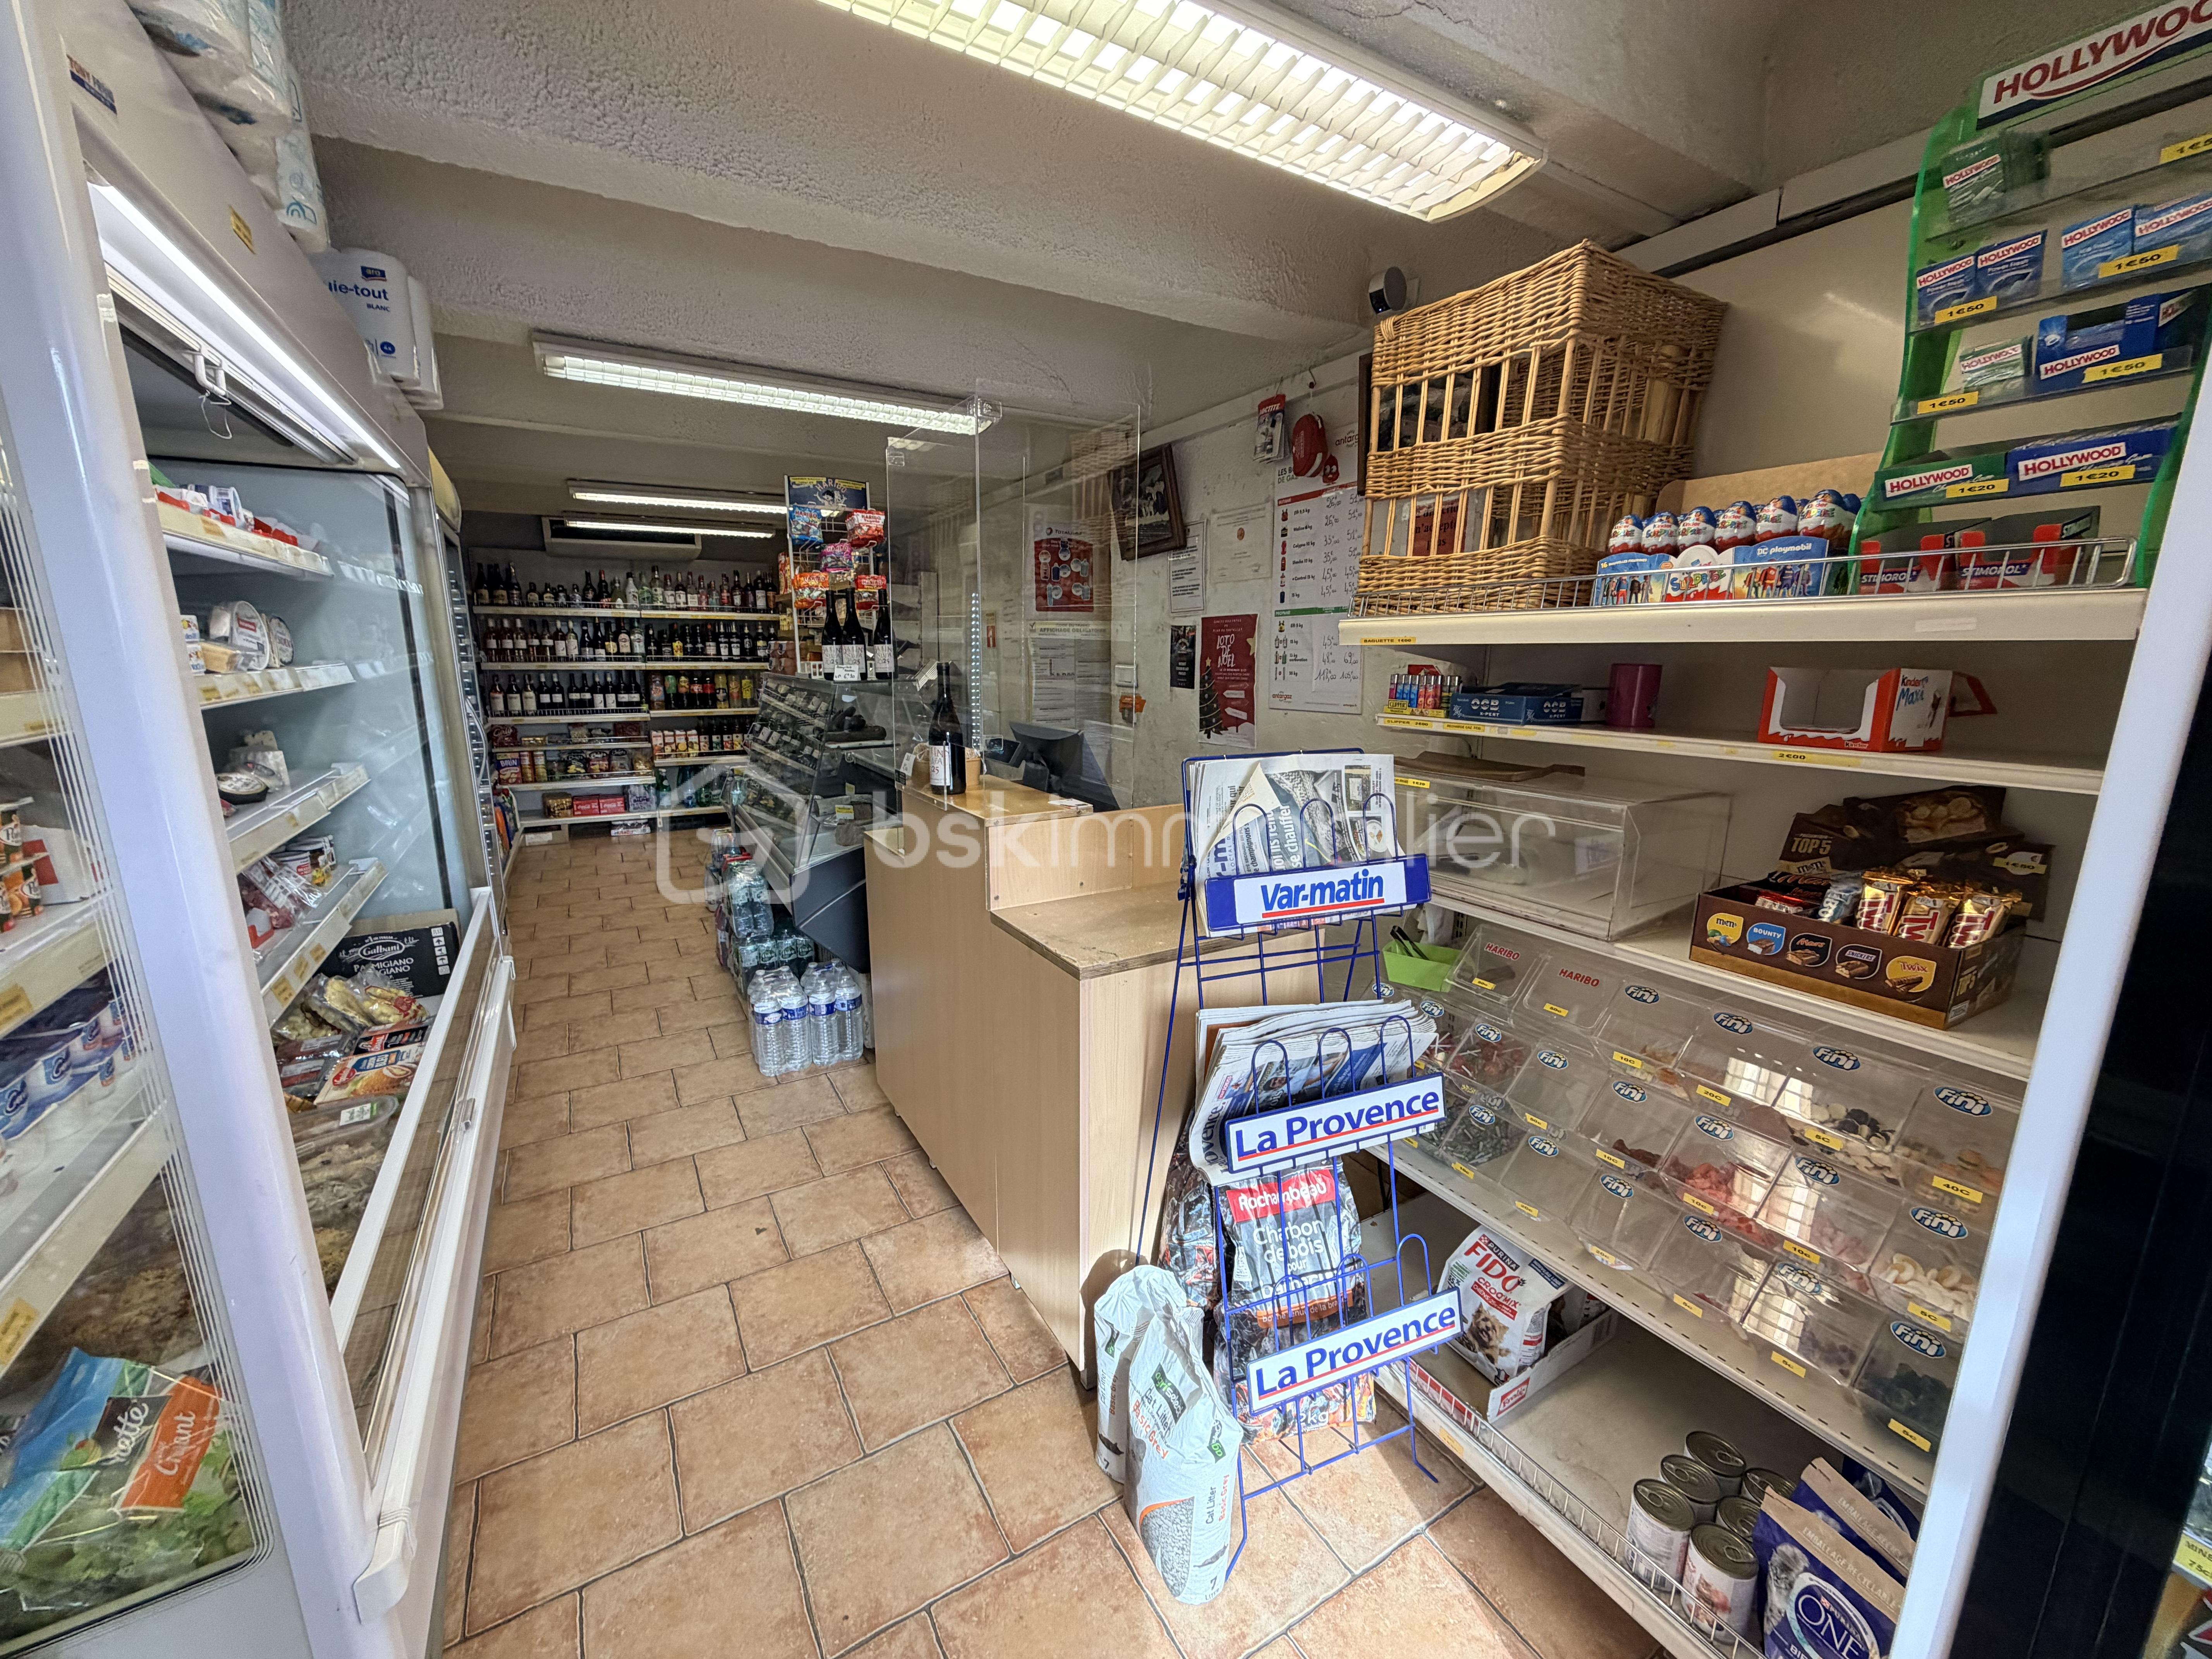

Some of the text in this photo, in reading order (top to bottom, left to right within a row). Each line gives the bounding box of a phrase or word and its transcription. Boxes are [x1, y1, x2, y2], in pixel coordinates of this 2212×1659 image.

[1980, 237, 2039, 265] HOLLYWOOD
[2115, 254, 2161, 270] 1€50
[1918, 259, 1972, 286] HOLLYWOOD
[366, 302, 390, 312] BLANC
[1947, 303, 1984, 317] 1€50
[2044, 348, 2117, 375] HOLLYWOOD
[2100, 362, 2145, 375] 1€50
[1930, 398, 1966, 408] 1€50
[2024, 446, 2122, 476] HOLLYWOOD
[1890, 467, 1969, 493] HOLLYWOOD
[2075, 471, 2119, 481] 1€20
[816, 479, 847, 494] HARIBO
[1959, 484, 1995, 493] 1€20
[795, 509, 817, 519] HARIBO
[1769, 543, 1812, 555] playmobil
[1216, 634, 1235, 649] LOTO
[1220, 644, 1231, 657] DE
[1471, 698, 1499, 711] OCB
[1543, 701, 1566, 713] OCB
[1279, 805, 1302, 868] se chauffer
[1244, 827, 1259, 867] champignons
[1791, 837, 1832, 855] TOP 5
[1261, 869, 1384, 912] Var-matin
[1752, 927, 1782, 939] BOUNTY
[362, 943, 400, 956] Galbani
[1484, 942, 1520, 961] HARIBO
[1796, 938, 1825, 949] Mars
[1846, 950, 1875, 962] SNICKERS
[1559, 968, 1600, 988] HARIBO
[1236, 1092, 1439, 1156] La Provence
[1239, 1180, 1327, 1212] Rochambeau
[1942, 1182, 1970, 1197] 40C
[1253, 1219, 1324, 1246] Charbon
[1264, 1238, 1324, 1264] de bois
[1487, 1242, 1518, 1269] PURINA
[1287, 1259, 1307, 1274] pour
[1464, 1241, 1521, 1293] FIDO
[1262, 1313, 1286, 1322] bone
[1310, 1306, 1318, 1314] de
[1256, 1367, 1297, 1395] La
[1305, 1307, 1455, 1375] Provence
[1155, 1372, 1184, 1417] agriselect
[1133, 1399, 1151, 1433] Basic
[1149, 1430, 1169, 1460] Grey
[1221, 1474, 1230, 1496] Grey
[1206, 1486, 1216, 1524] Cat Litter
[1802, 1527, 1847, 1567] EMBALLAGE
[1210, 1575, 1218, 1590] 7
